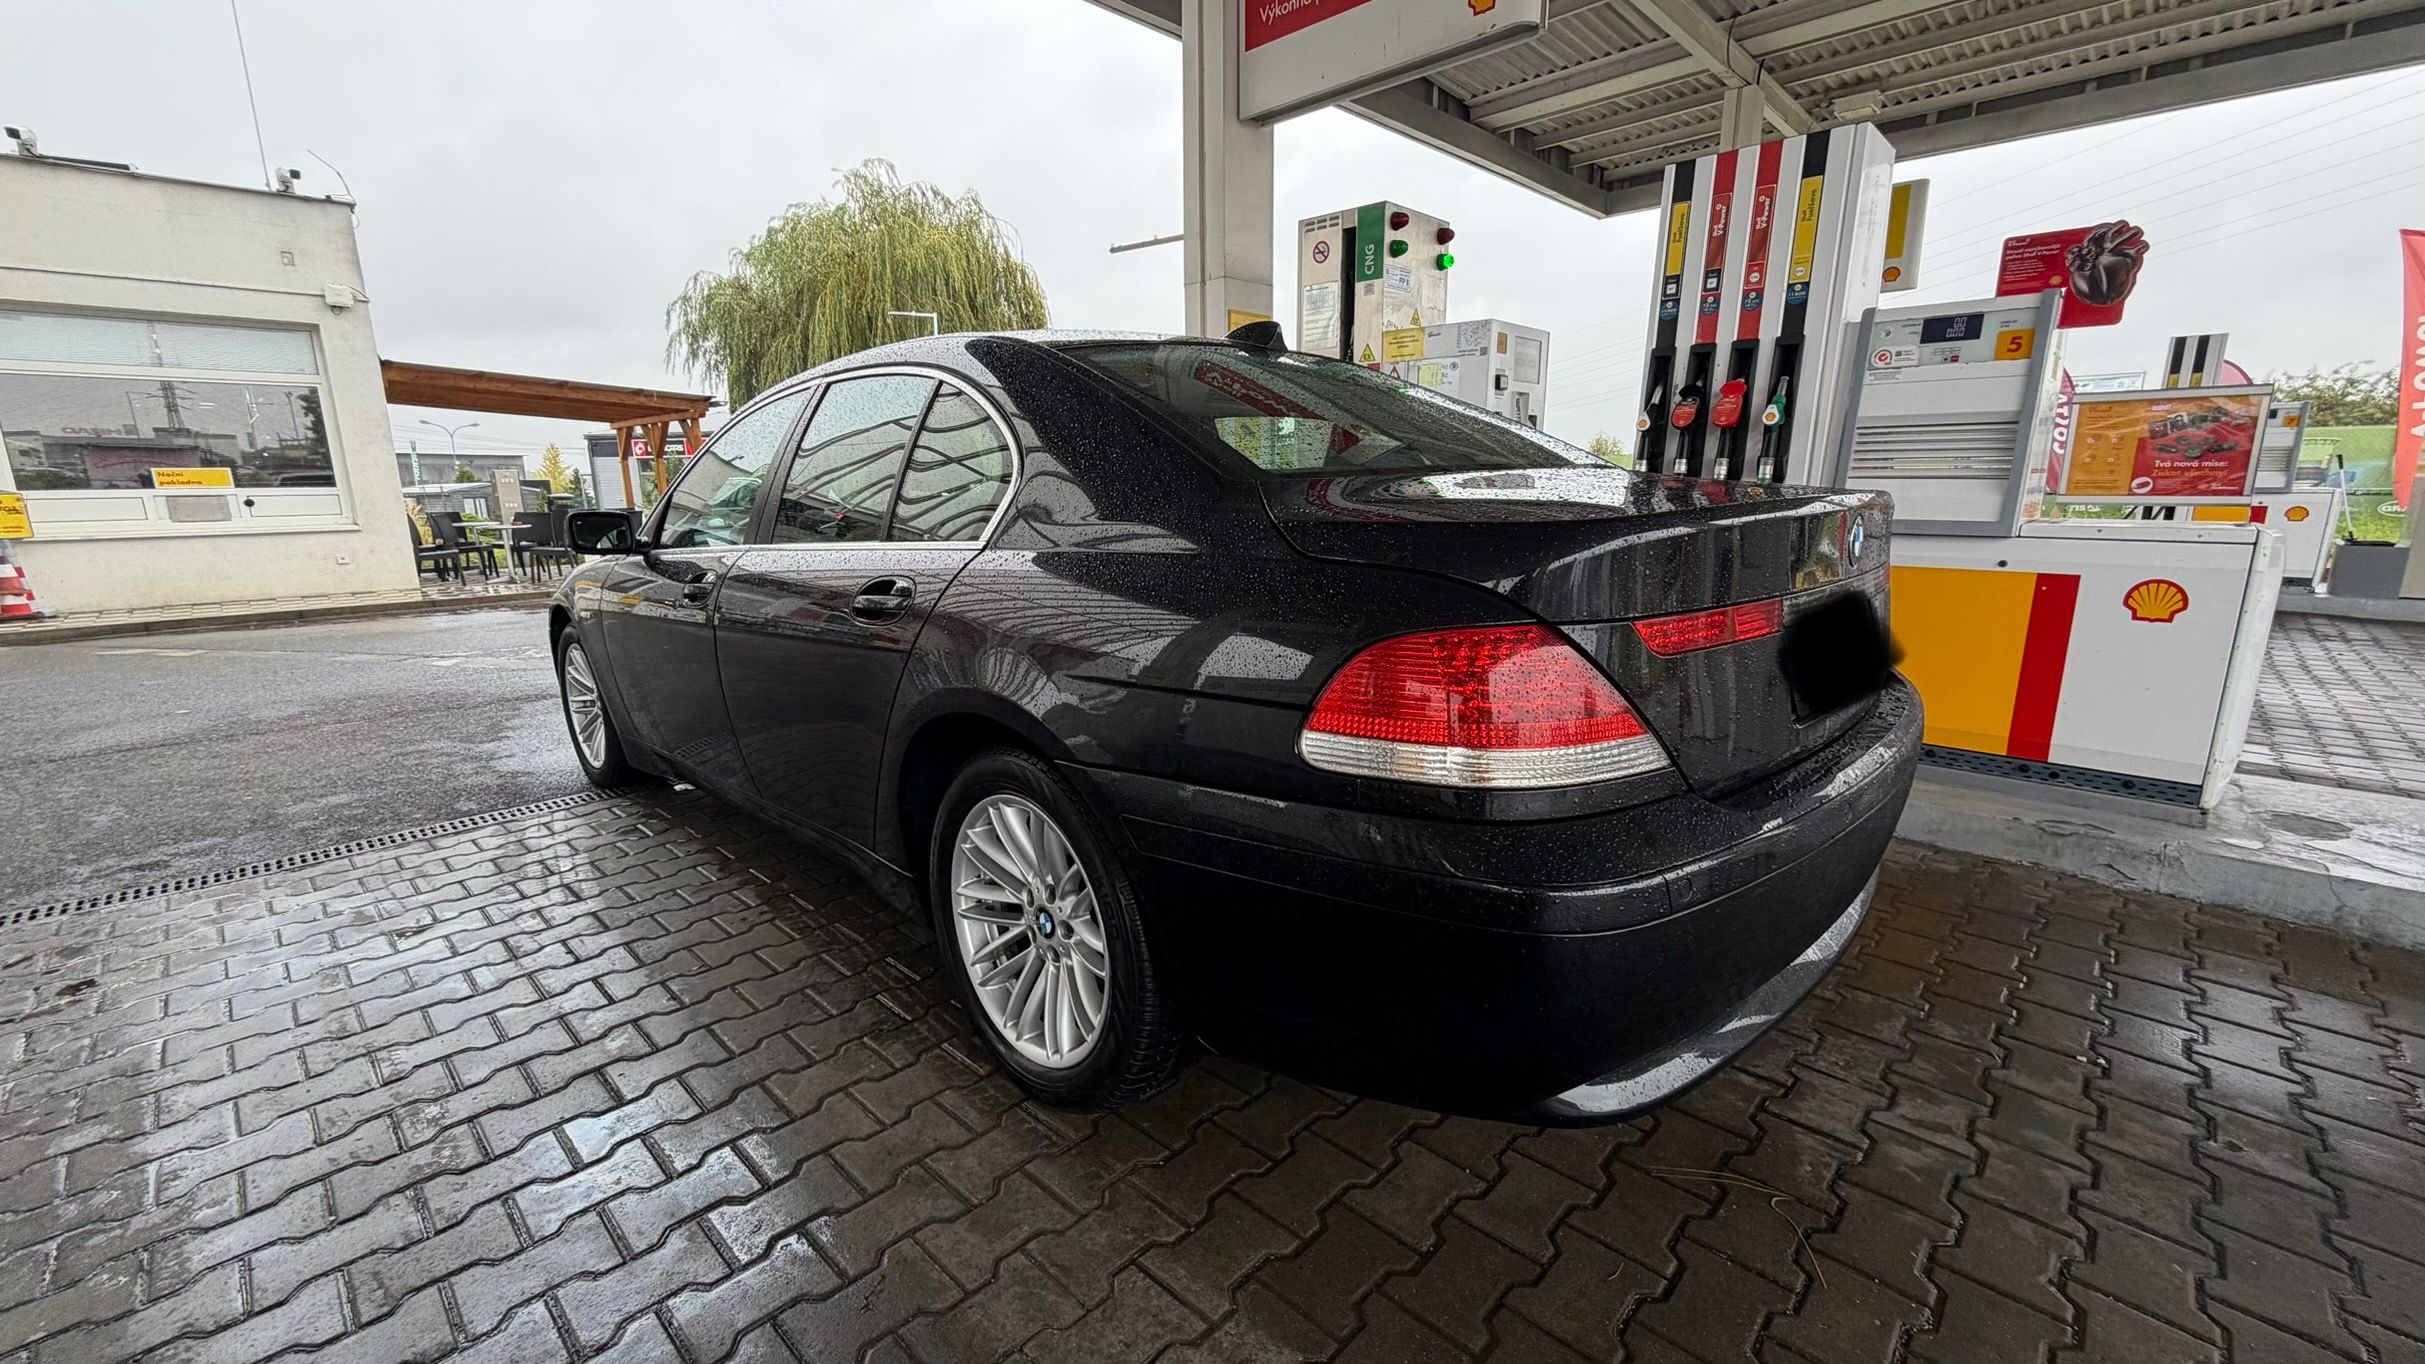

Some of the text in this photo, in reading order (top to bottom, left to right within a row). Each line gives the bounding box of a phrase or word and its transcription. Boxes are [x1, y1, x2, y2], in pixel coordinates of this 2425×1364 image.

[1717, 206, 1727, 236] V-Power
[1760, 197, 1771, 229] V-Power
[1364, 244, 1375, 275] CNG
[2006, 335, 2024, 353] 5
